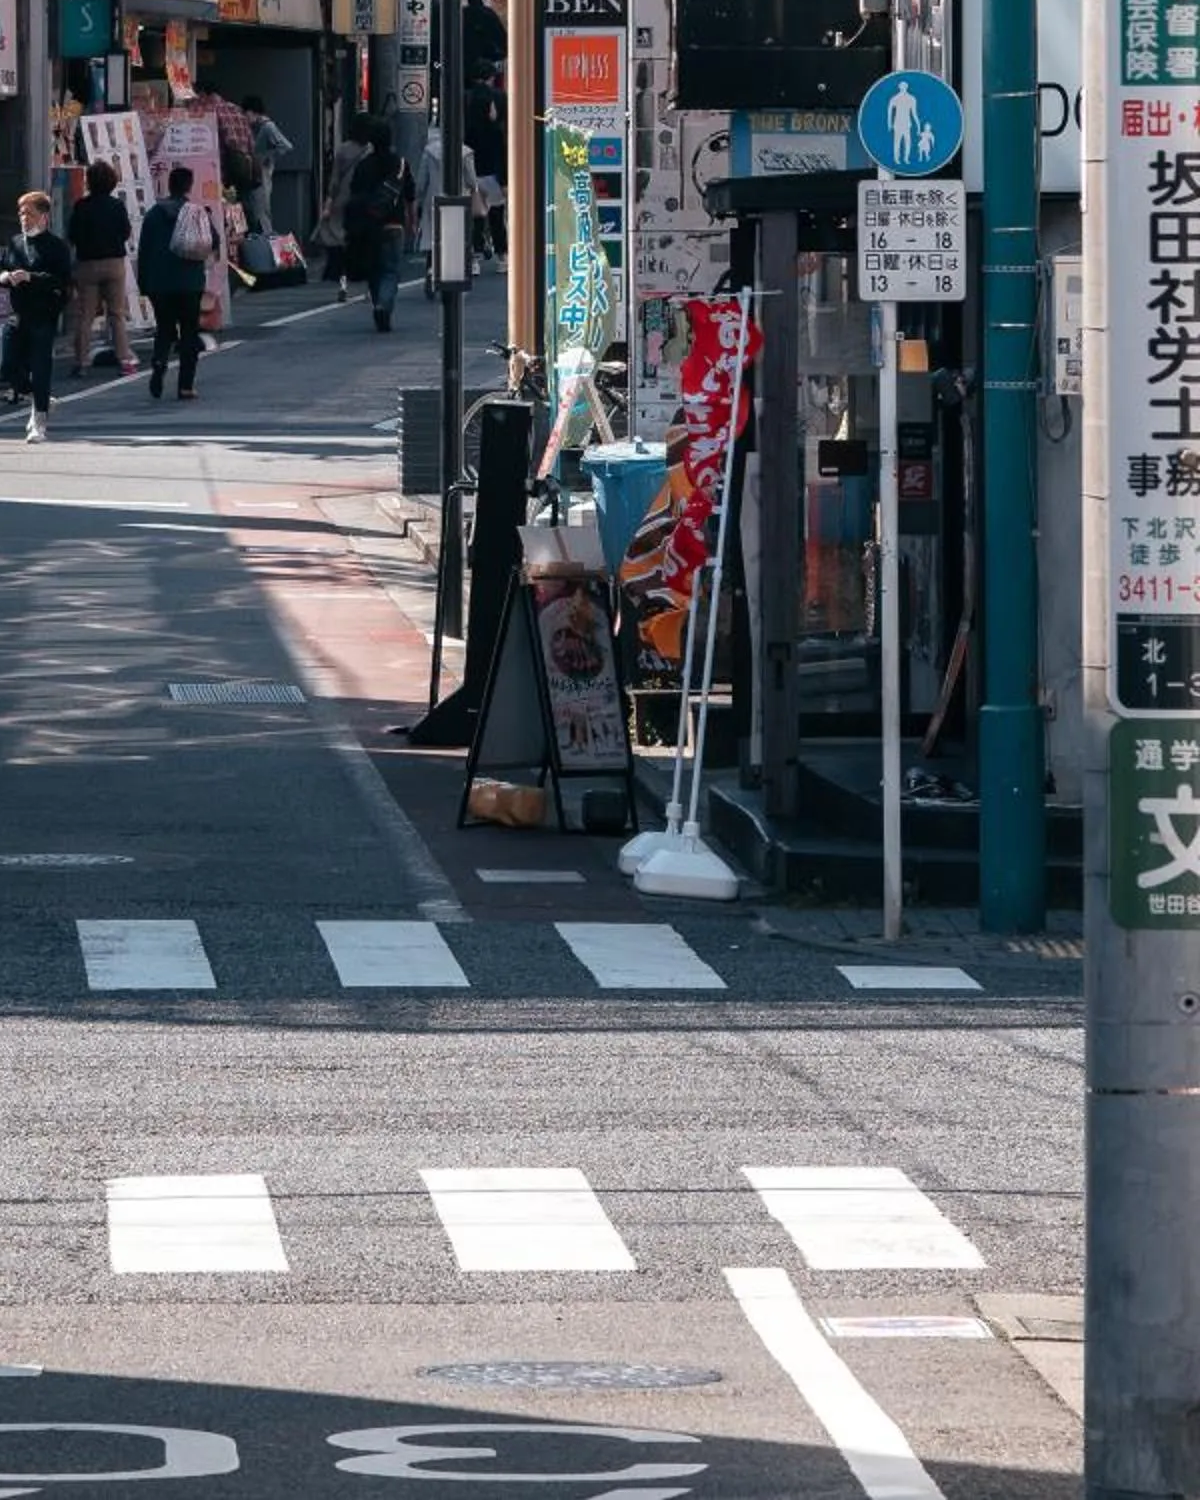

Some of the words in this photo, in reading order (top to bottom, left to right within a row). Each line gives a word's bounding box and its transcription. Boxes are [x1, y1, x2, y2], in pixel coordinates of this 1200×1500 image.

[750, 113, 786, 132] THE
[792, 113, 852, 133] BRONX
[865, 189, 958, 206] 自転車を除く
[870, 231, 888, 249] 16
[935, 231, 953, 249] 18
[865, 254, 958, 271] 日曜・休日は
[871, 275, 889, 293] 13
[935, 275, 953, 293] 18
[1146, 150, 1200, 442] 坂田社労士
[1121, 516, 1196, 540] 下北沢
[1141, 637, 1167, 664] 北
[1135, 739, 1200, 772] 通学
[1137, 784, 1200, 889] 文
